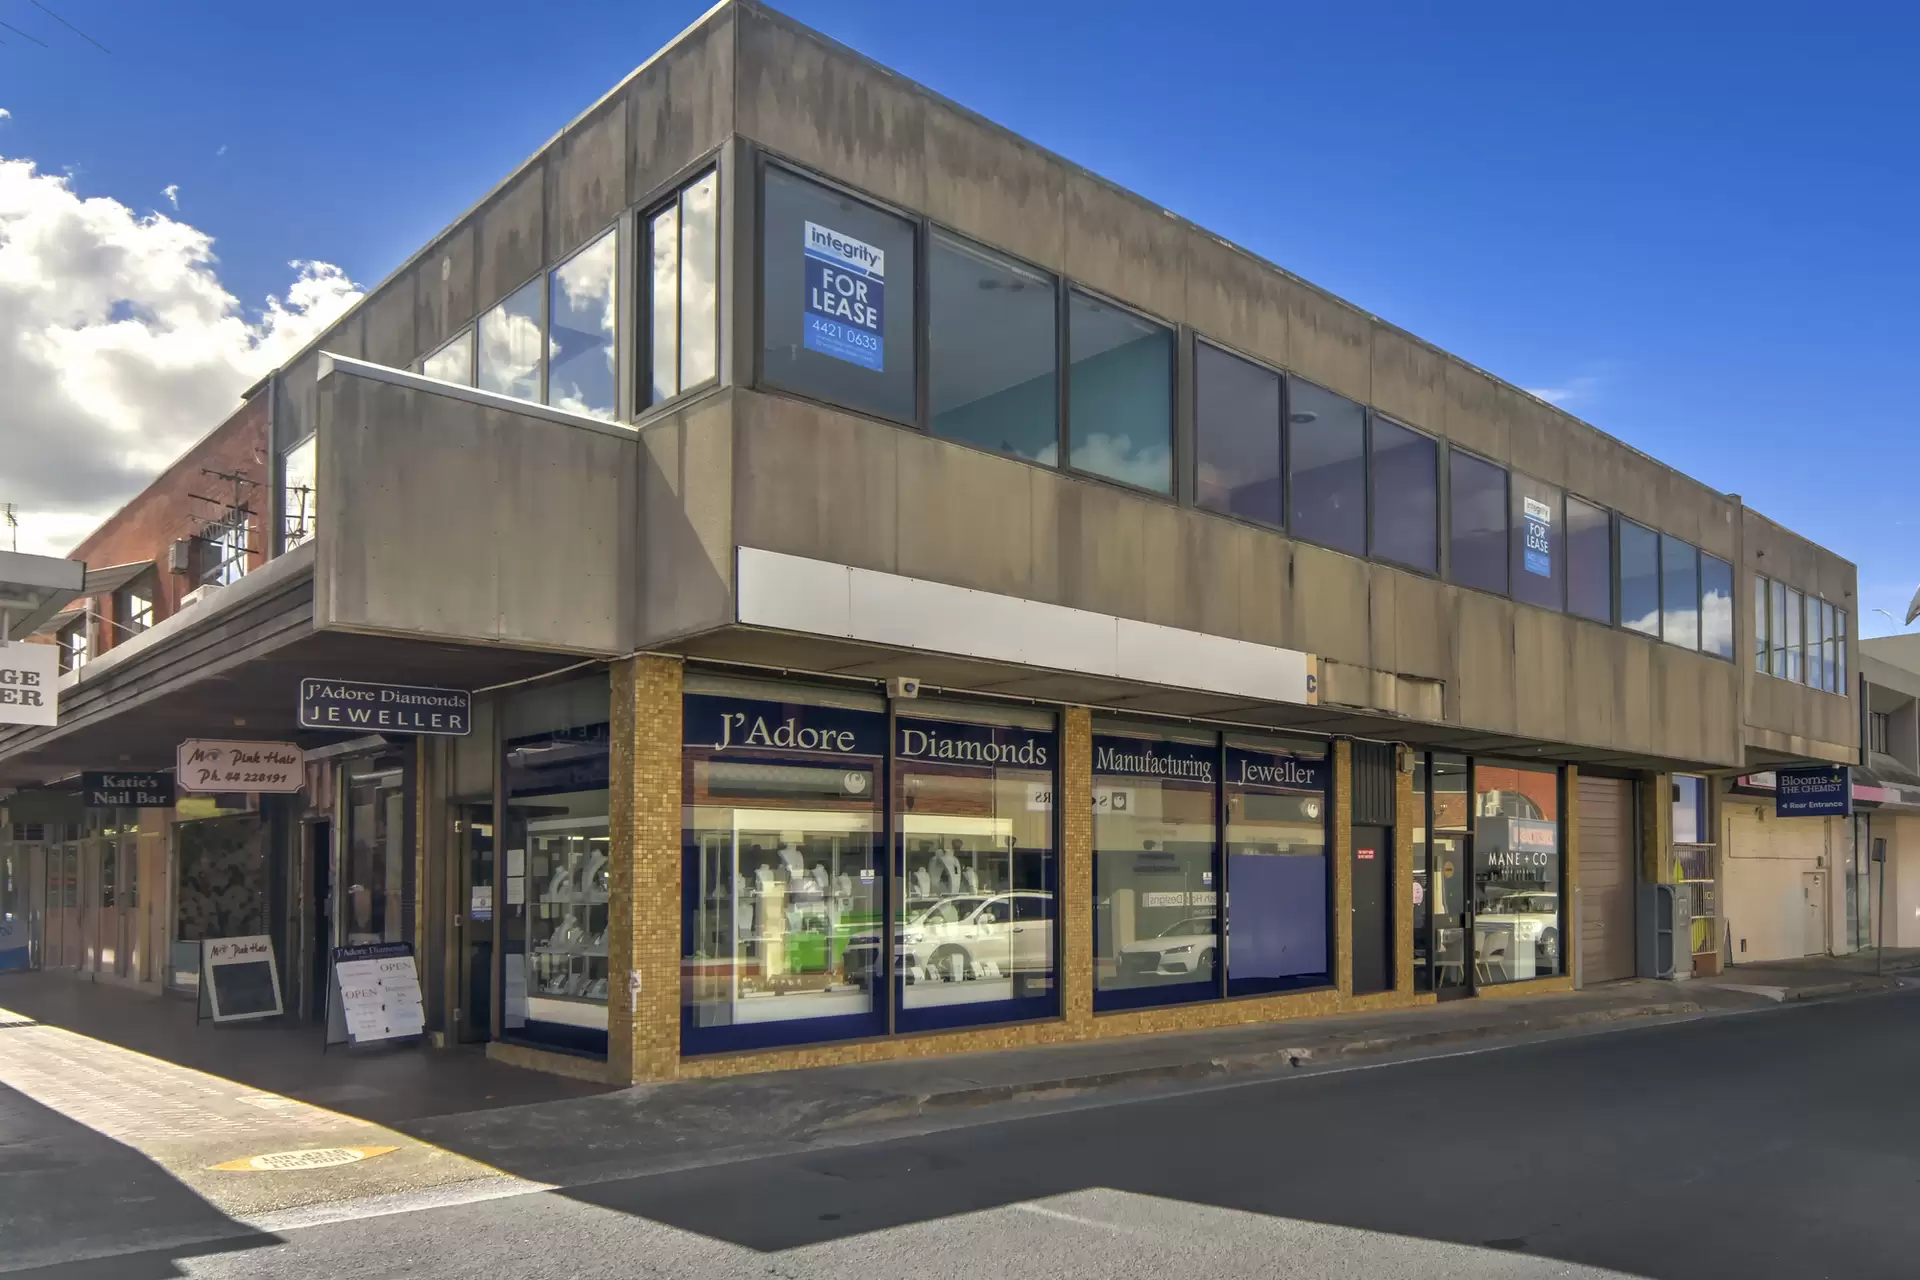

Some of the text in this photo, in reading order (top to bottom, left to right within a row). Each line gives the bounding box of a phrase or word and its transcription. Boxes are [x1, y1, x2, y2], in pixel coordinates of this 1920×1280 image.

[811, 227, 878, 267] integrity
[823, 268, 868, 304] FOR
[812, 287, 877, 329] LEASE
[812, 319, 842, 339] 4421
[847, 330, 877, 351] 0633
[1530, 522, 1546, 539] FOR
[1526, 534, 1549, 554] LEASE
[0, 669, 40, 687] GE
[0, 688, 44, 707] ER
[306, 684, 467, 708] J'Adore Diamonds
[311, 706, 462, 729] JEWELLER
[715, 712, 1048, 766] J'Adore Diamonds
[230, 748, 261, 767] Pink
[264, 751, 297, 765] Hair
[1096, 746, 1315, 786] Manufacturing Jeweller
[102, 775, 158, 788] Katie's
[225, 771, 240, 782] 44
[1781, 775, 1828, 786] Blooms
[93, 791, 167, 804] Nail Bar
[1781, 783, 1842, 794] THE CHEMIST
[1809, 801, 1843, 809] Entrance
[1488, 851, 1521, 866] MANE
[1532, 852, 1548, 866] CO
[380, 962, 411, 972] OPEN
[345, 988, 378, 1000] OPEN
